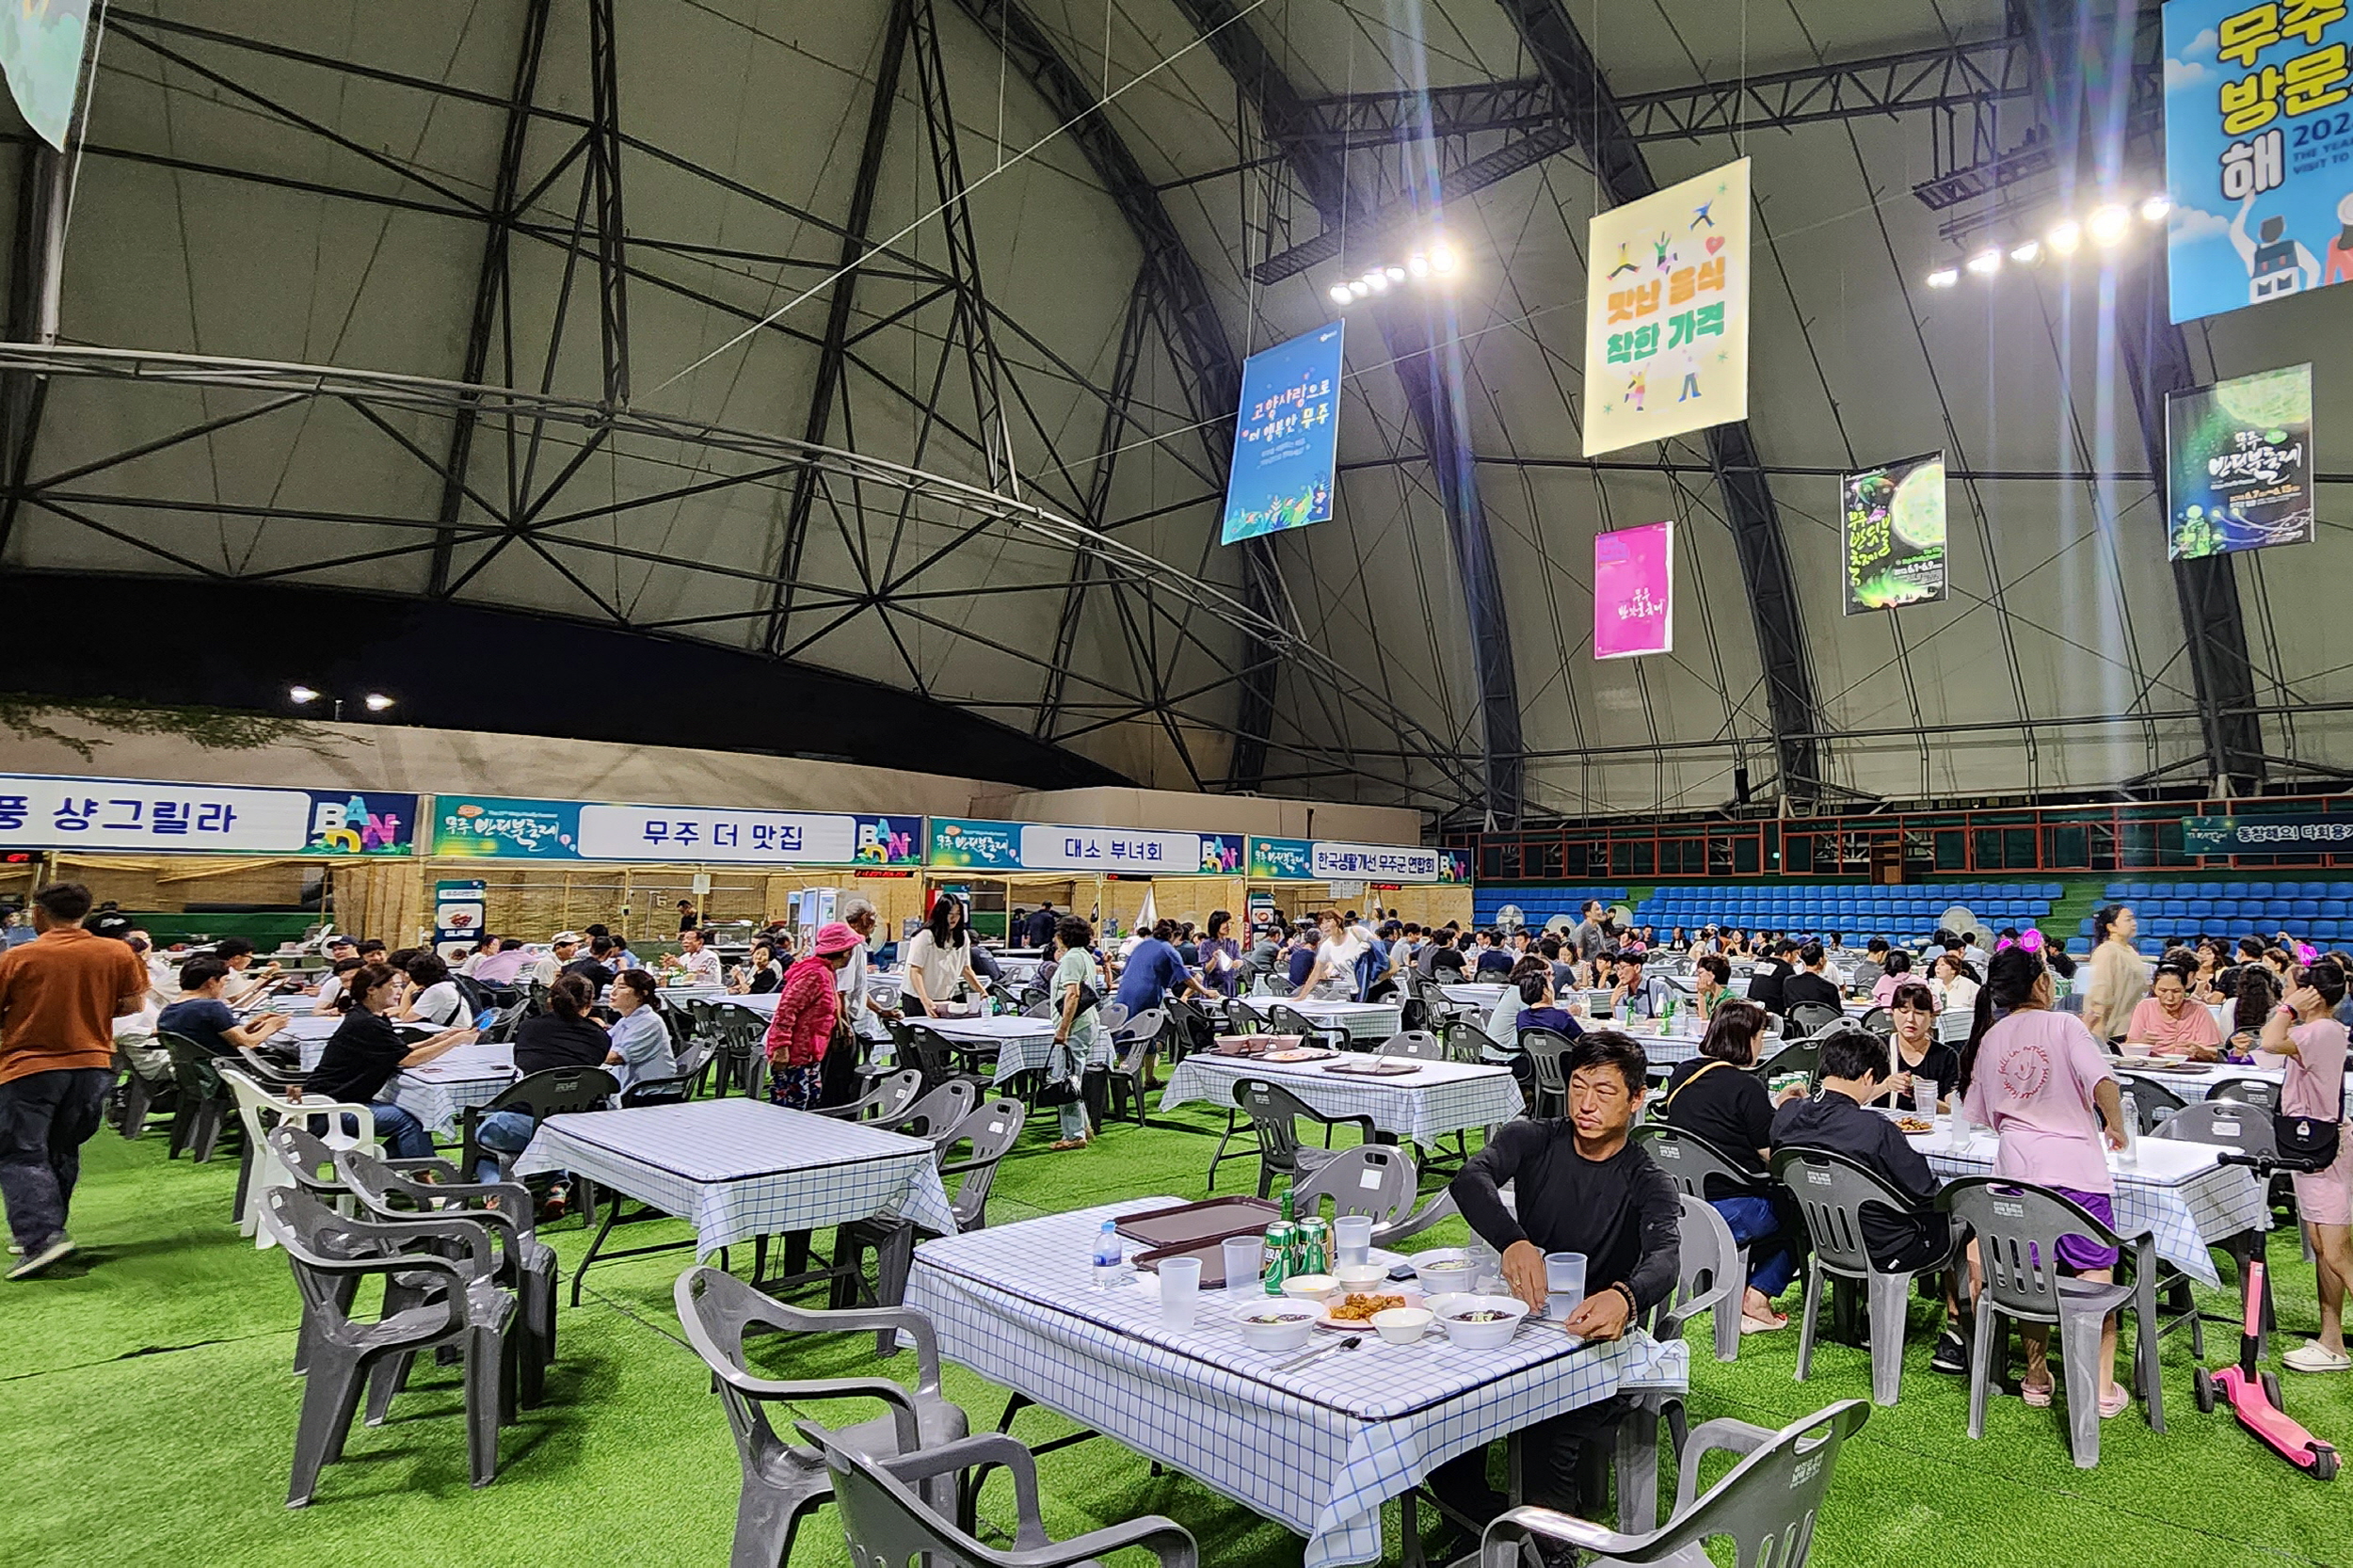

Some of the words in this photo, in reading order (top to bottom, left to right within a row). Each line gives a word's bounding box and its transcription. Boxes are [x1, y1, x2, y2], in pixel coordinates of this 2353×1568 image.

[2217, 0, 2347, 68] 무주
[2220, 41, 2353, 136] 방문
[2292, 112, 2353, 149] 202
[2218, 127, 2285, 200] 해
[1607, 278, 1662, 326] 맛난
[1669, 256, 1725, 306] 음식
[1607, 322, 1661, 364] 착한
[1668, 301, 1725, 349] 가격
[1301, 403, 1330, 429] 무주
[53, 797, 238, 834] 샹그릴라
[2237, 825, 2299, 842] 동참해요!
[642, 820, 699, 847] 무주
[713, 823, 740, 848] 더
[751, 824, 804, 852] 맛집
[1064, 838, 1101, 858] 대소
[1110, 840, 1163, 861] 부녀회
[1318, 852, 1376, 872] 한국생활개선
[1378, 855, 1406, 873] 무주군
[1407, 856, 1434, 874] 연합회
